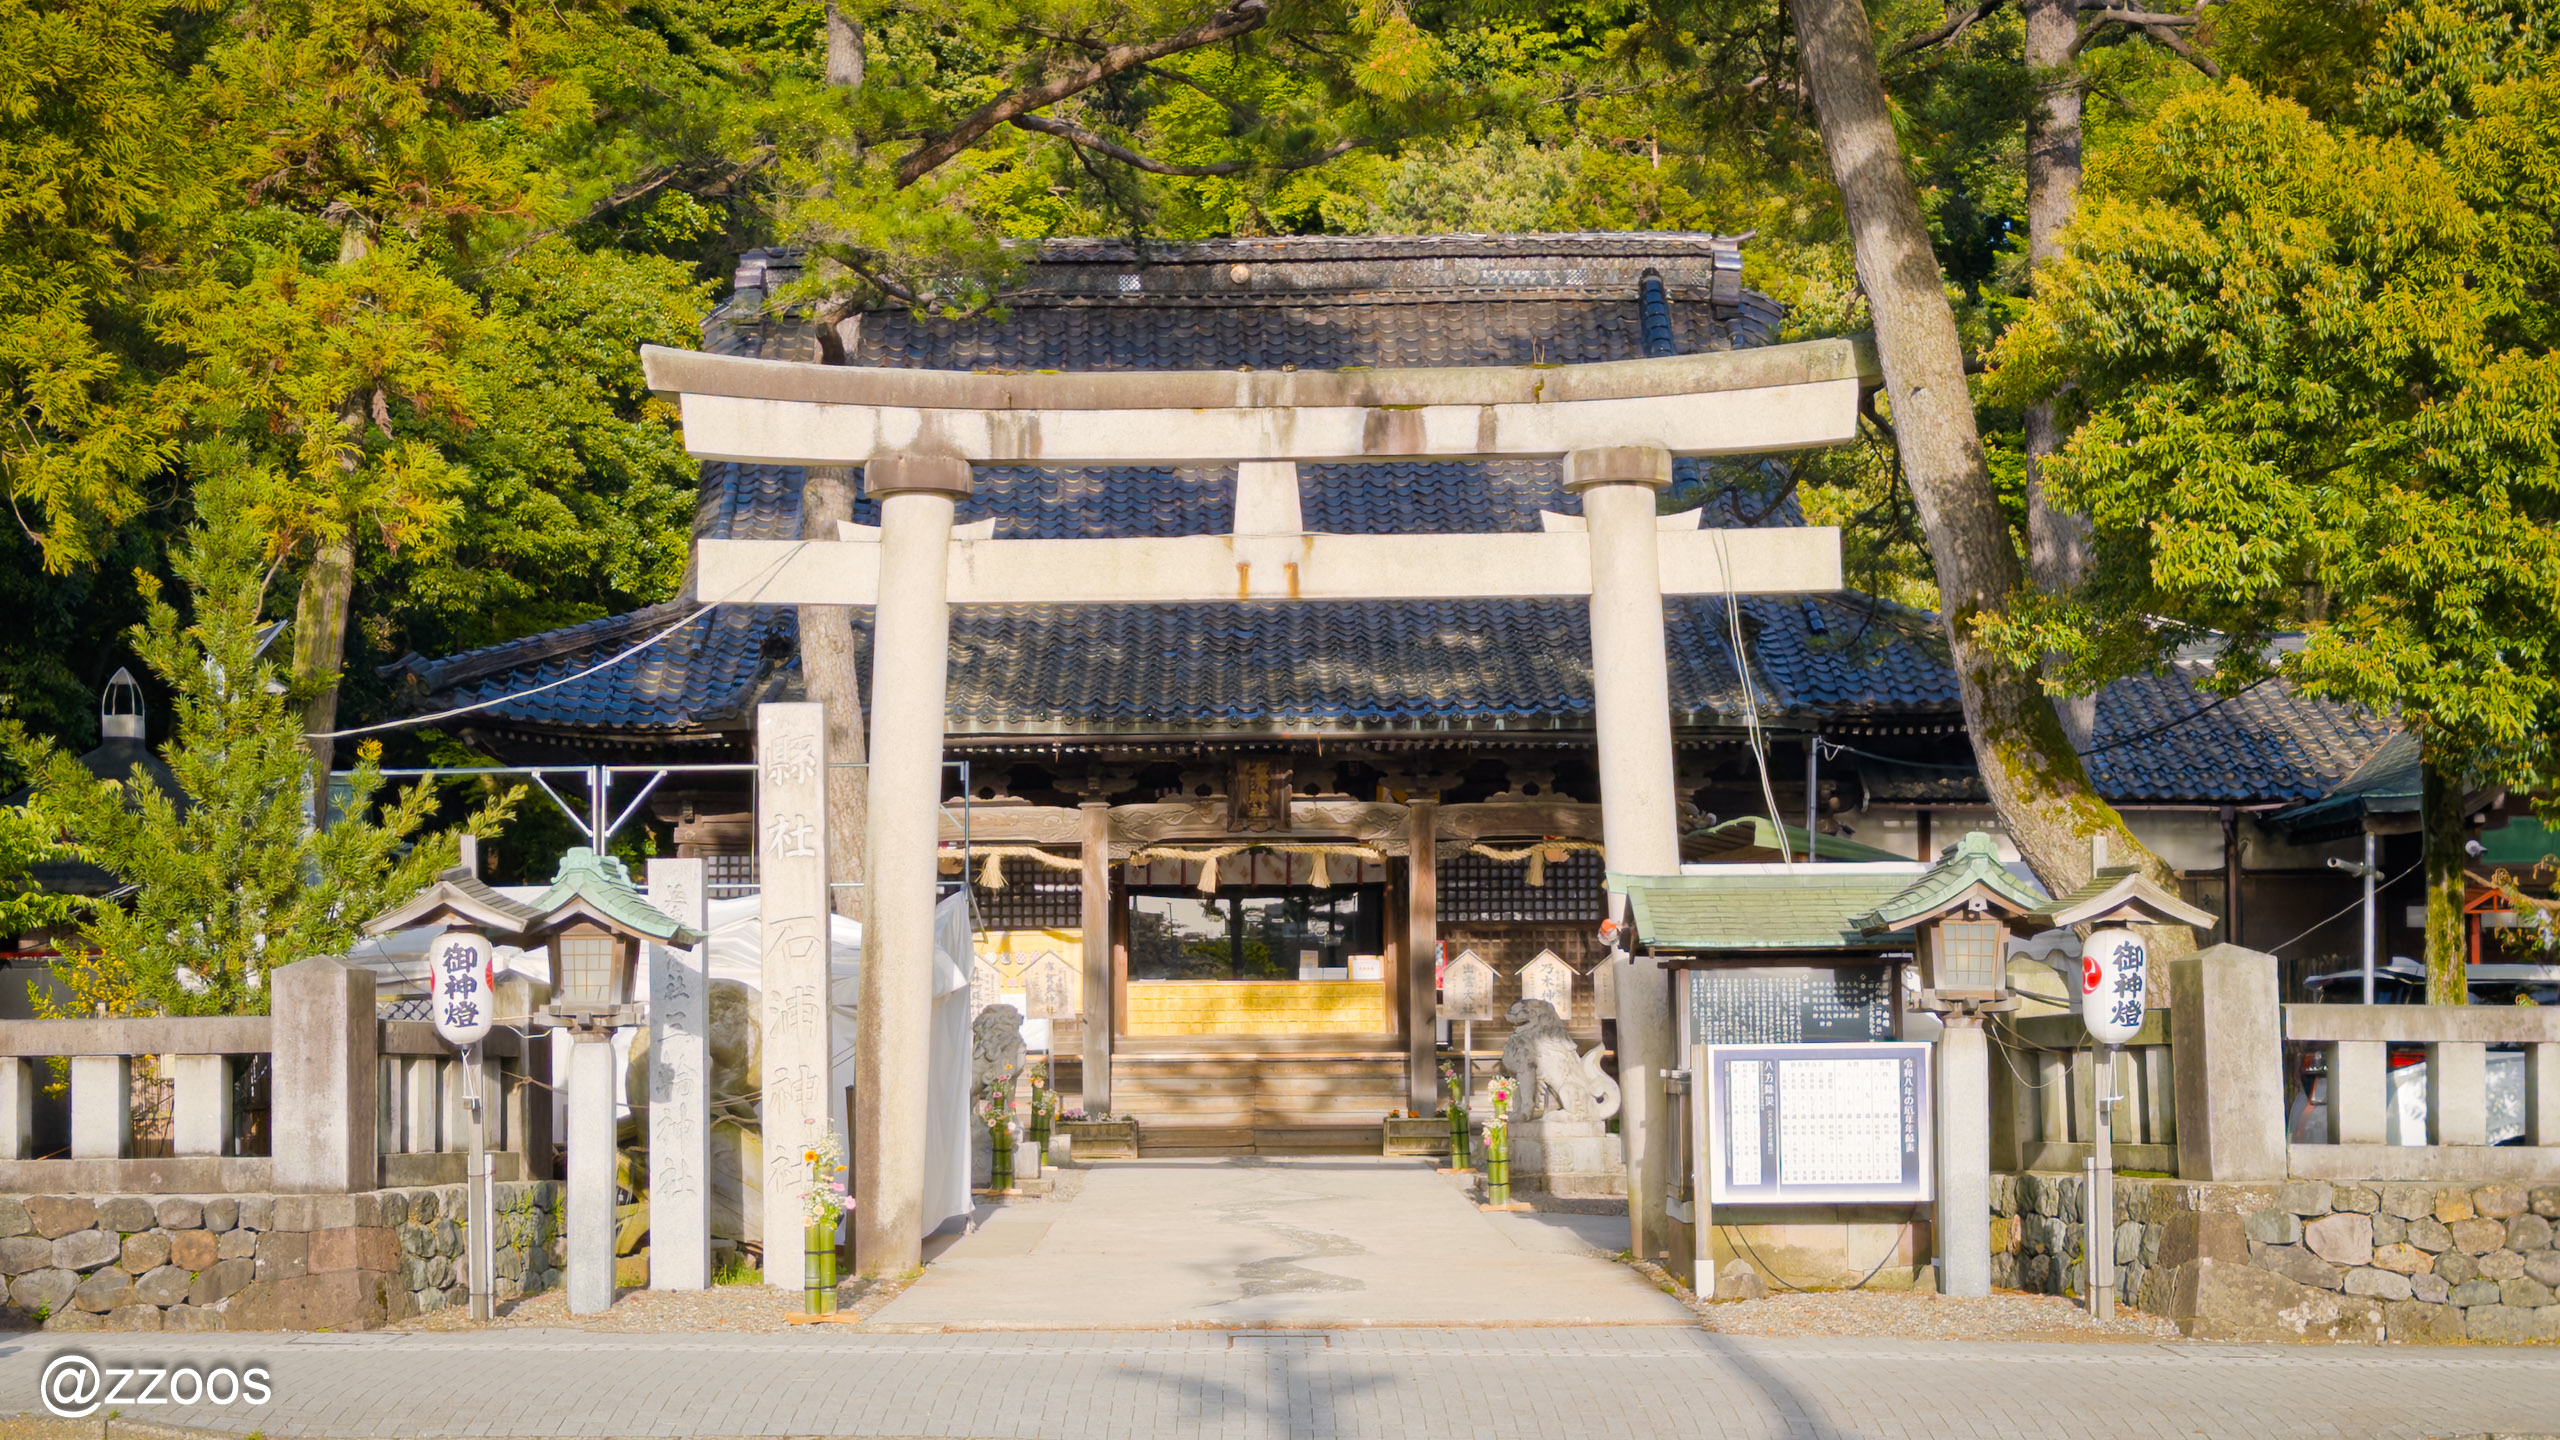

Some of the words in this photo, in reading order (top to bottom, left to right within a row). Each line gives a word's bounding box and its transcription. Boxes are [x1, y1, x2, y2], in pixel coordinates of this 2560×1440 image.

[442, 942, 480, 1028] 御神燈
[1460, 963, 1477, 1014] 出雲大社
[1539, 963, 1555, 1001] 乃木神
[2110, 940, 2144, 1027] 御神燈
